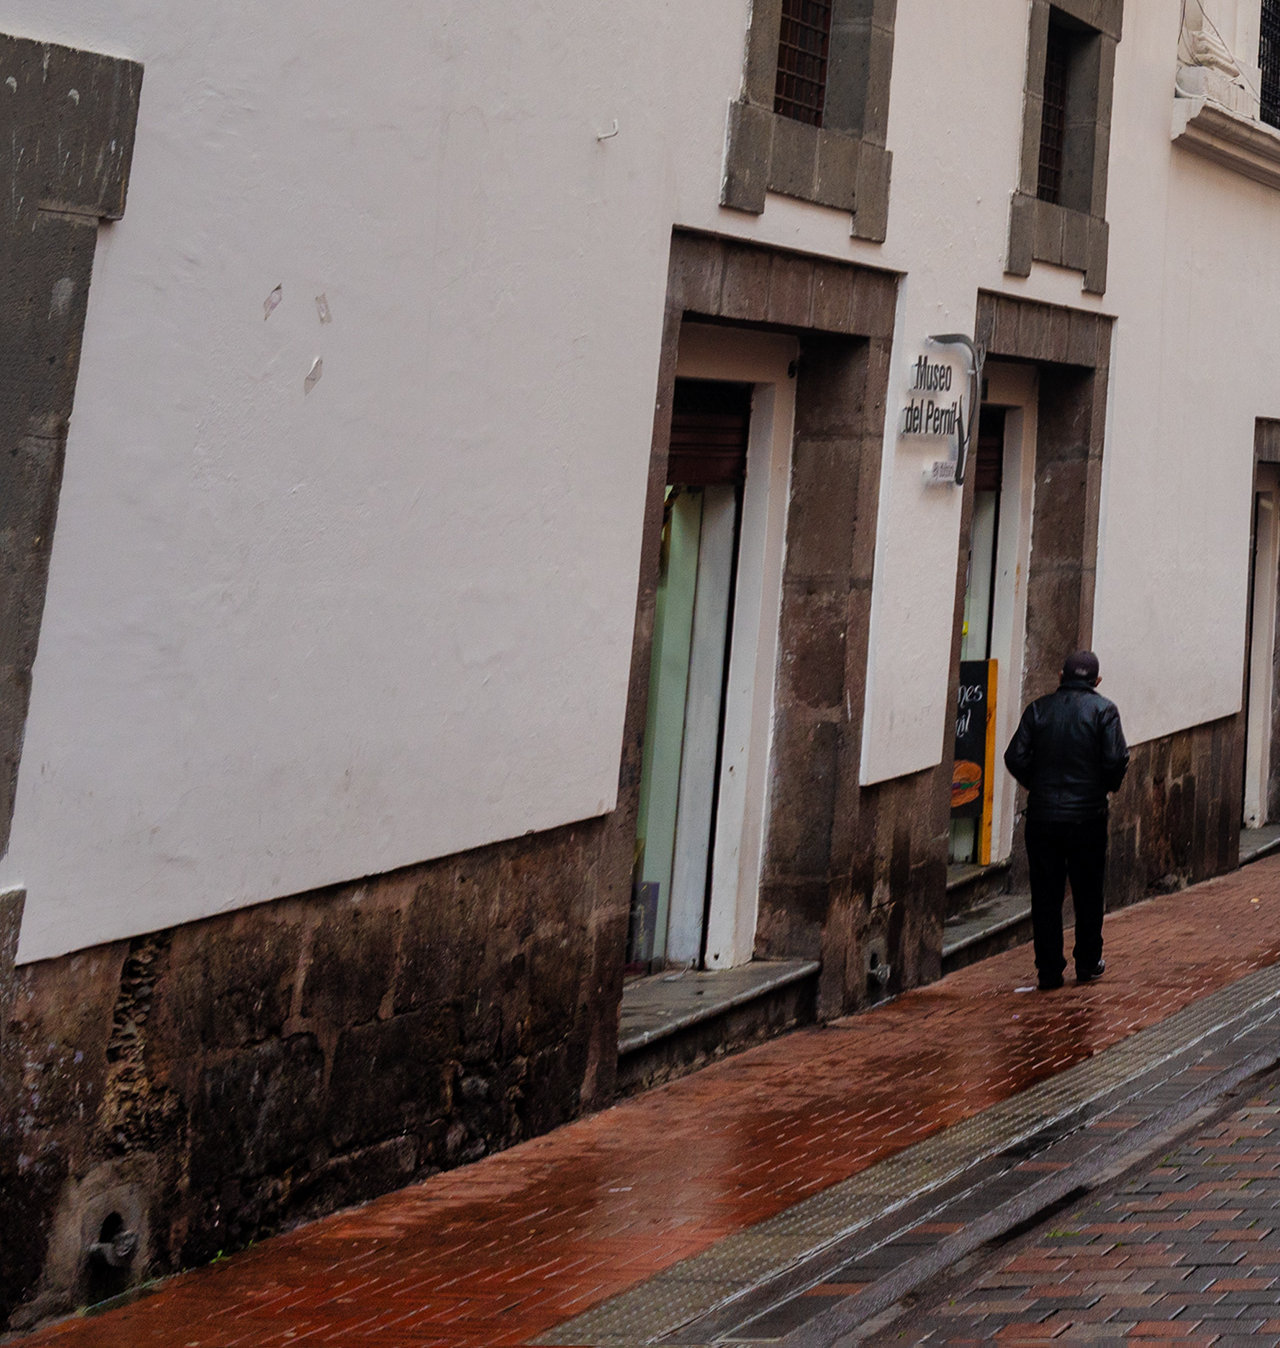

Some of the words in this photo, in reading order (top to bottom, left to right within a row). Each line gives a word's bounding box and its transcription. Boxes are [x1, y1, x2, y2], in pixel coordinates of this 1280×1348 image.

[914, 355, 952, 392] Museo
[903, 398, 924, 434] del
[925, 399, 957, 435] Pernil
